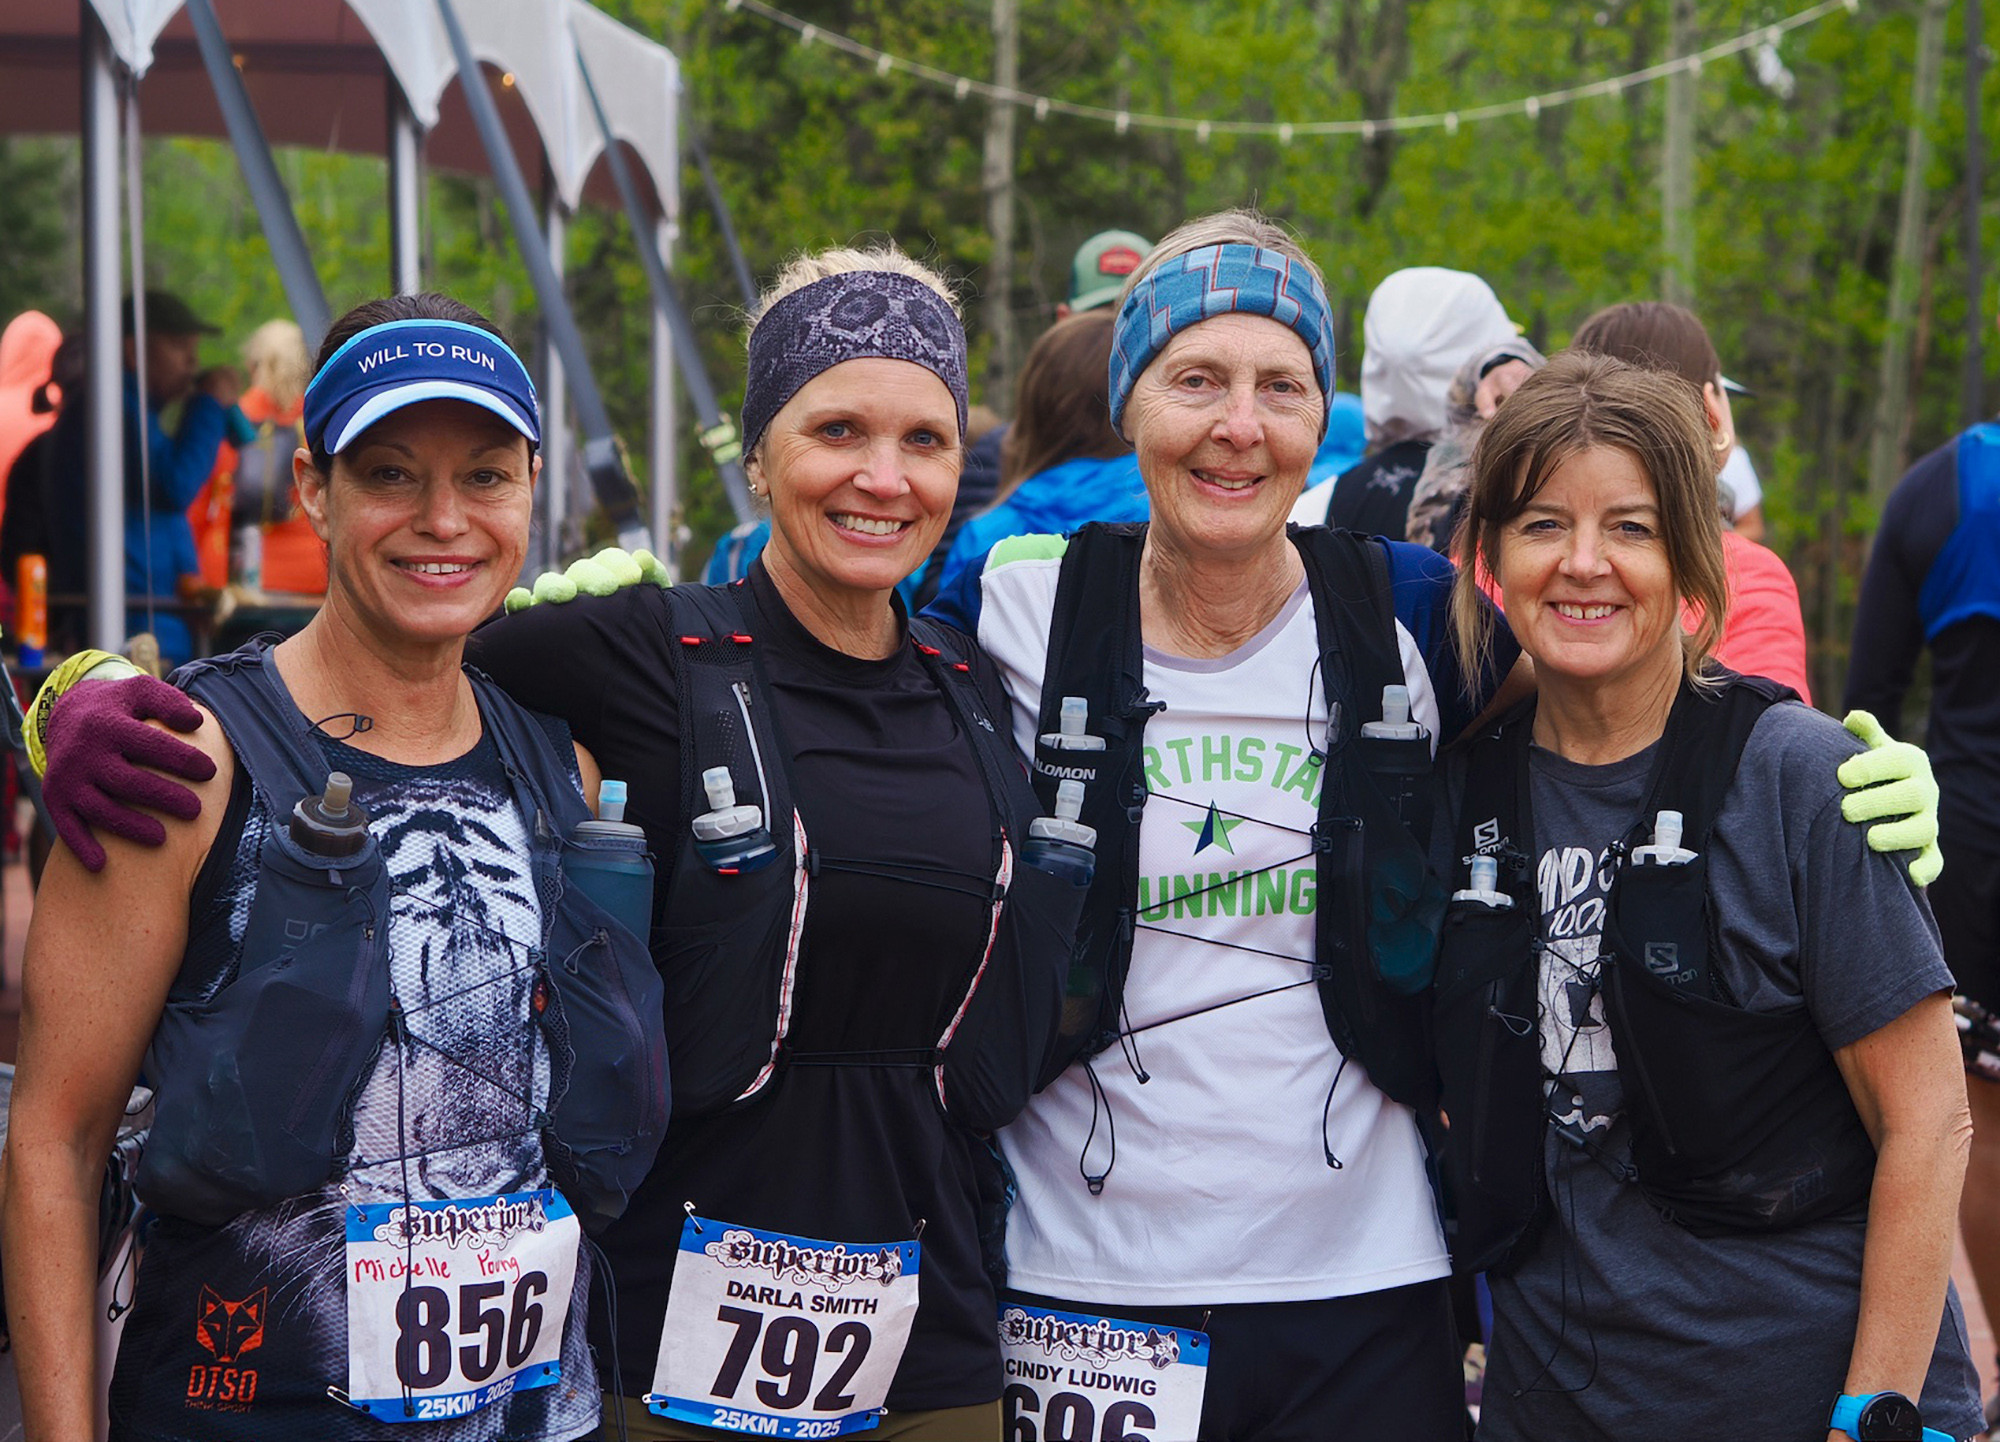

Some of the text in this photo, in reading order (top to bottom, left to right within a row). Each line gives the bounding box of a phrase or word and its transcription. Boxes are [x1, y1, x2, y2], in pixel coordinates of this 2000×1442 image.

[358, 343, 495, 373] WILL TO RUN
[1035, 757, 1096, 780] LOMON
[1143, 735, 1321, 808] RTHSTA
[1139, 869, 1317, 922] UNNING
[1537, 847, 1594, 916] AND
[1549, 897, 1606, 938] 10,0
[355, 1256, 450, 1283] Michelle
[727, 1281, 878, 1315] DARLA SMITH
[396, 1271, 548, 1389] 856
[709, 1305, 872, 1412] 792
[1005, 1358, 1157, 1396] CINDY LUDWIG
[418, 1393, 477, 1418] 25KM
[485, 1375, 517, 1404] 2025
[711, 1408, 779, 1435] 25KM
[794, 1419, 842, 1438] 2025
